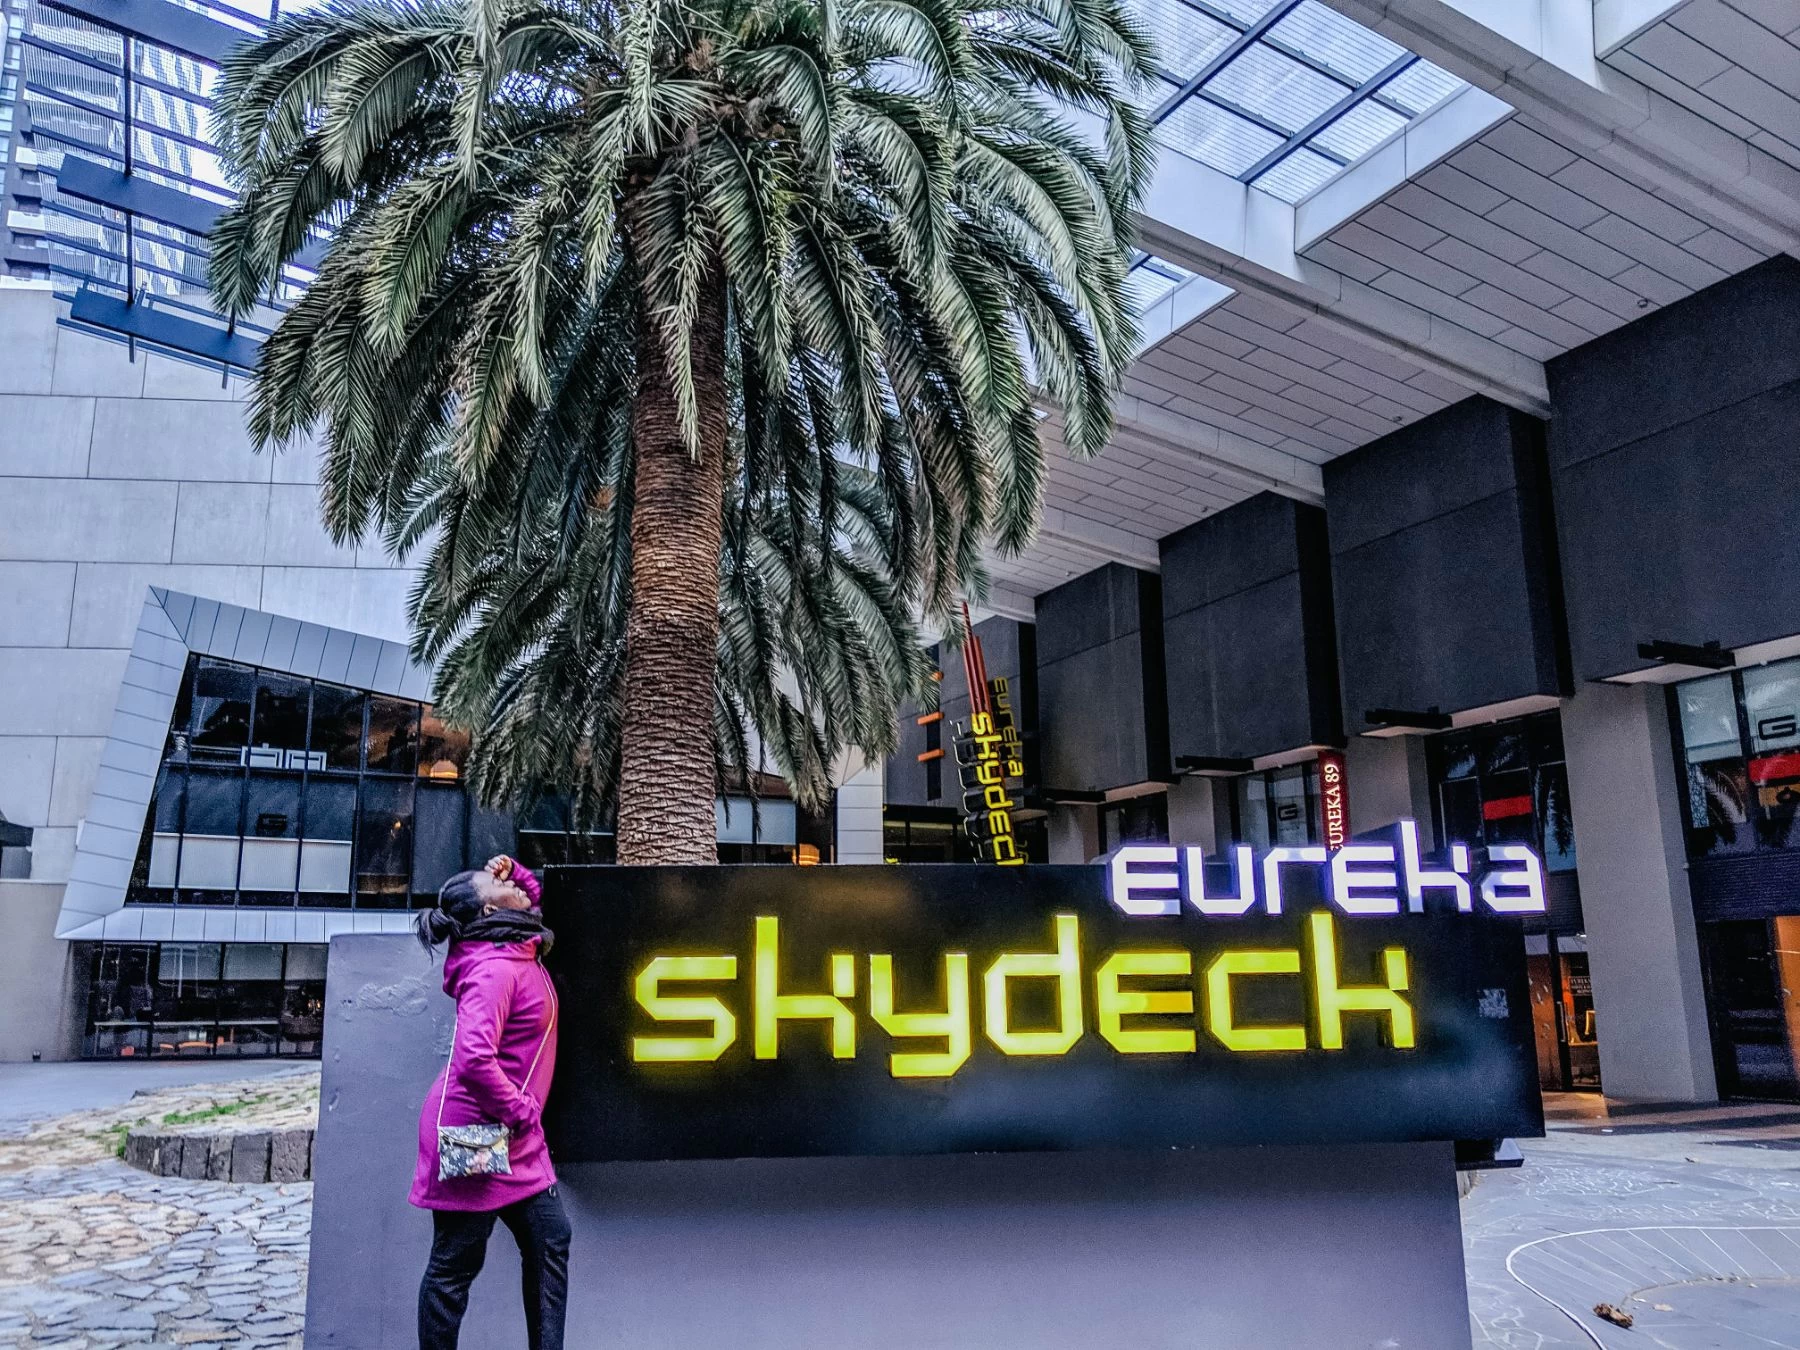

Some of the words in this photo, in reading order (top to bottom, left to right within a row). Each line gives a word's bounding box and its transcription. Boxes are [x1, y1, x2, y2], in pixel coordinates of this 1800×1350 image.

[1324, 763, 1341, 783] 89
[1111, 820, 1547, 915] eureka
[631, 912, 1417, 1079] skydeck
